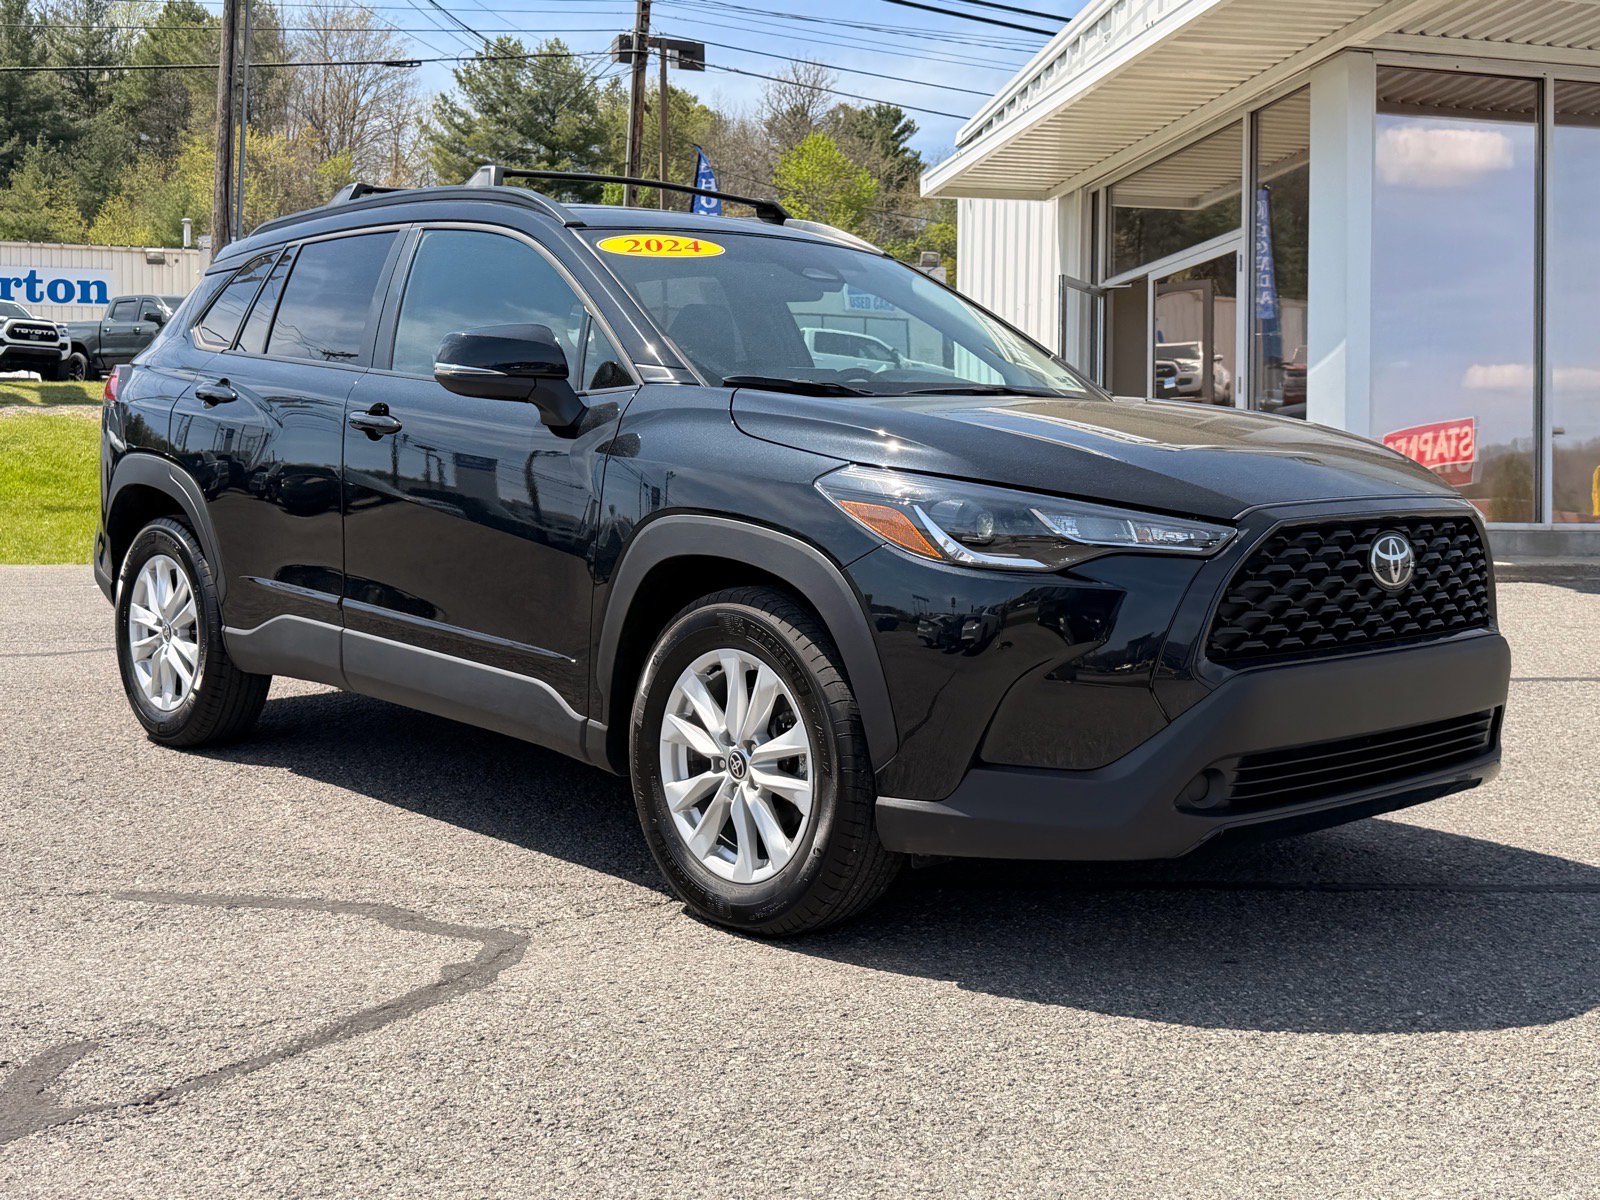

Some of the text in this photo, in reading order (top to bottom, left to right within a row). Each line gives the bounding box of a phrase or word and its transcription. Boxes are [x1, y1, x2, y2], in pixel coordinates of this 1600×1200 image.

[623, 239, 702, 253] 2024
[0, 269, 110, 304] rton
[850, 296, 871, 309] USED
[13, 327, 56, 336] TOYOTA
